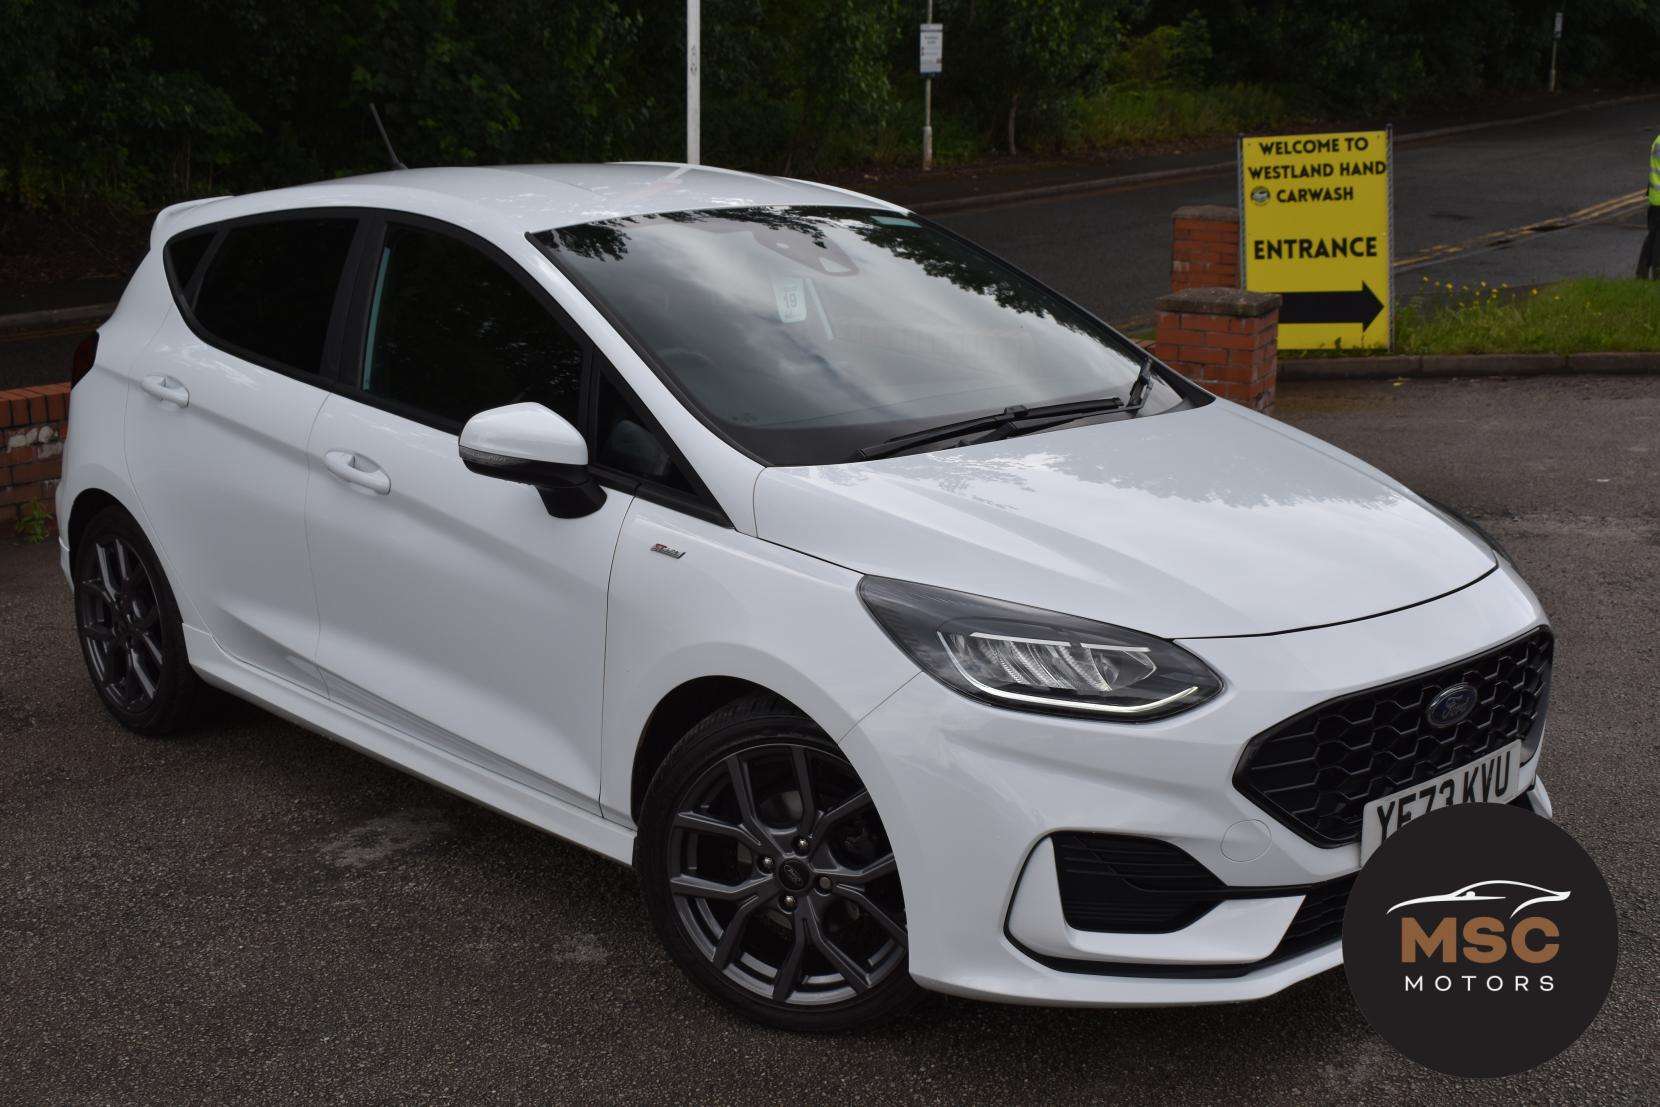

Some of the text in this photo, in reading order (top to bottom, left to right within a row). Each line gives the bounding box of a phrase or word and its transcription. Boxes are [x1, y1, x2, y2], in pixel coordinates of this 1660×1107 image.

[1259, 137, 1369, 155] WELCOME TO
[1248, 161, 1386, 180] WESTLAND HAND
[1276, 187, 1354, 203] CARWASH
[1254, 237, 1378, 260] ENTRANCE
